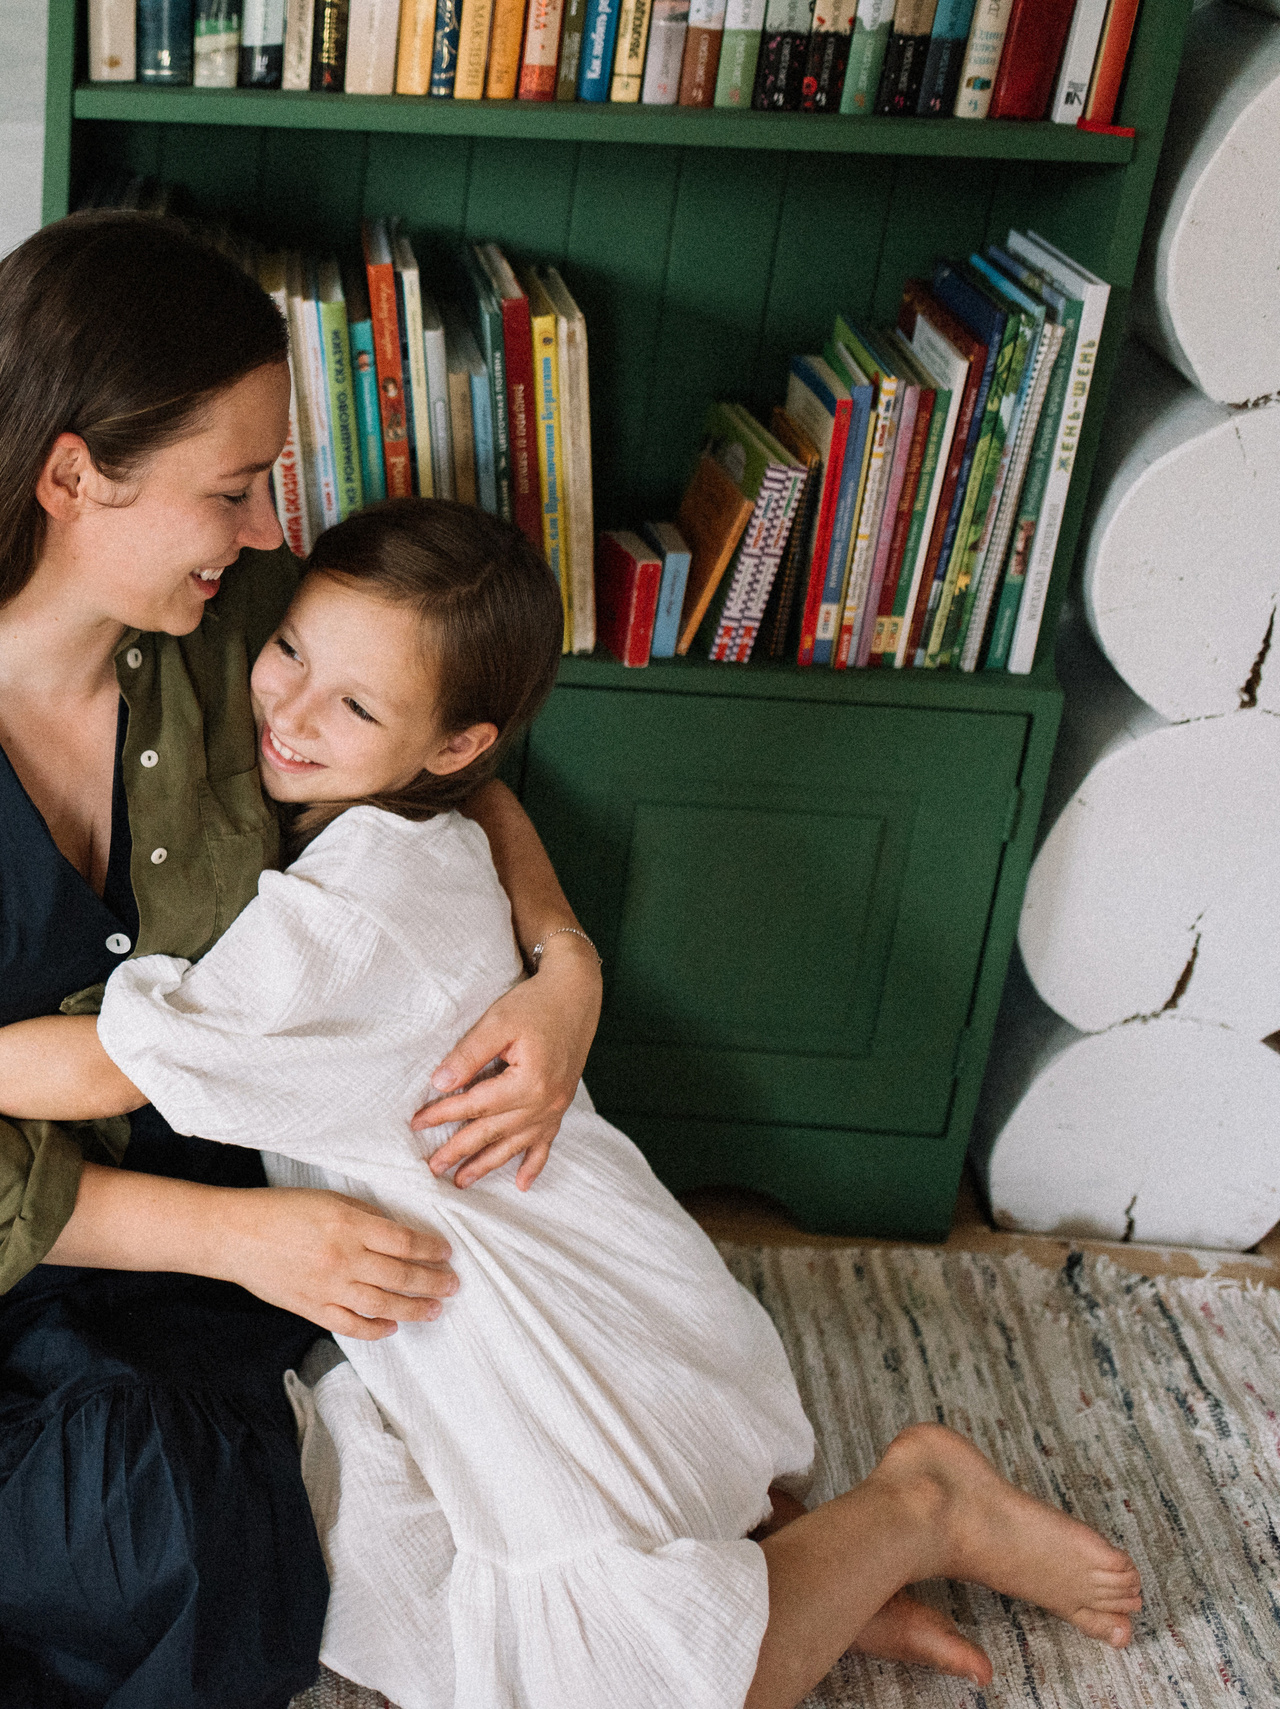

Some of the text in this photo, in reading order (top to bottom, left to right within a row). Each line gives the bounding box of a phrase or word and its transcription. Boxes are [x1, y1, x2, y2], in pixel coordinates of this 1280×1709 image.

[586, 57, 603, 80] Как
[329, 329, 344, 384] СКАЗКИ
[538, 356, 556, 419] Буратино
[1056, 340, 1097, 474] ЖЕНЬ-ШЕНЬ
[280, 462, 300, 513] СКАЗОК
